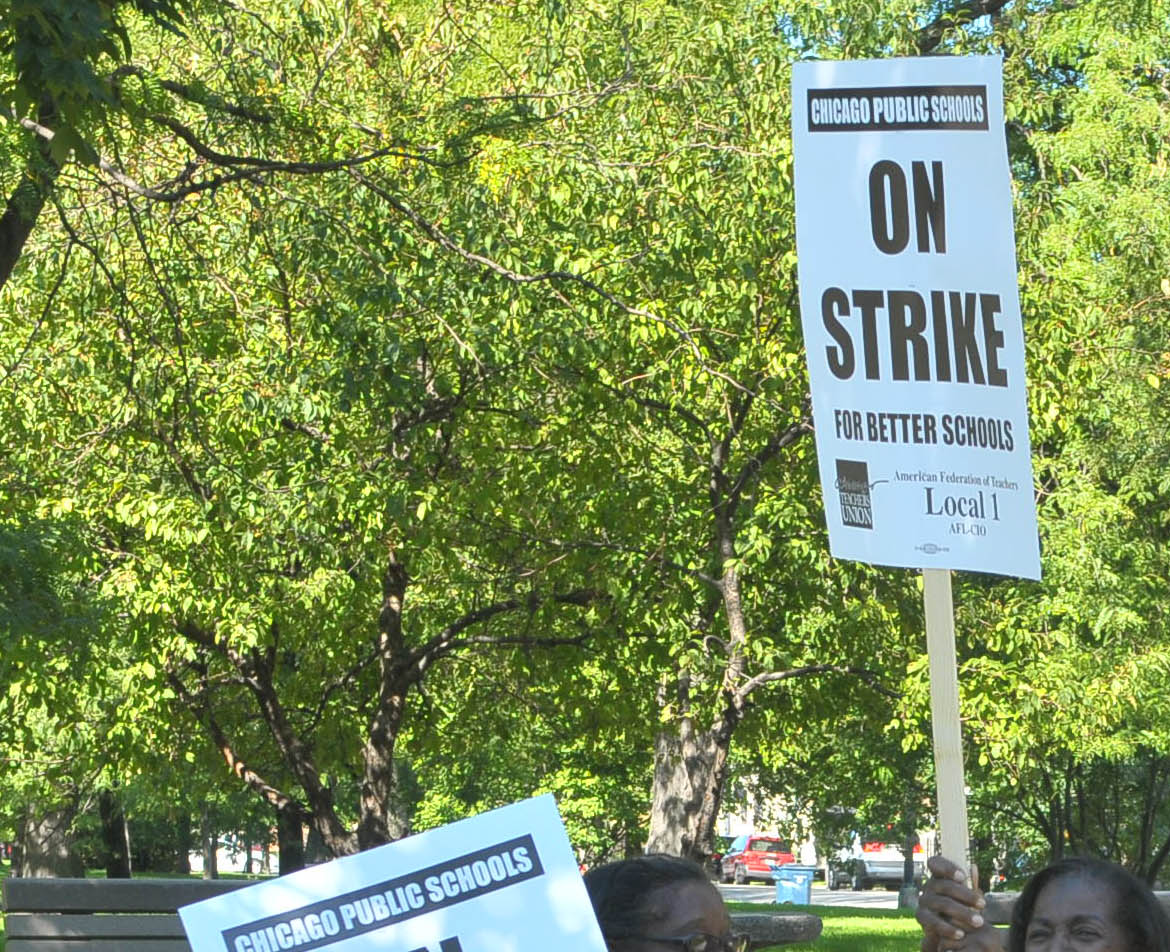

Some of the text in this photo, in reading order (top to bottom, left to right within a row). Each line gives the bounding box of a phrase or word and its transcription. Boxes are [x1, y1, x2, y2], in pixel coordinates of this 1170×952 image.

[811, 95, 984, 125] CHICAGO PUBLIC SCHOOLS
[869, 160, 946, 255] ON
[822, 287, 1008, 387] STRIKE
[834, 409, 1014, 452] FOR BETTER SCHOOLS
[894, 470, 938, 482] American
[940, 471, 982, 486] Federation
[983, 476, 990, 486] of
[842, 505, 872, 525] UNION
[924, 487, 1000, 521] Local 1
[949, 523, 987, 537] AFL-CIO
[339, 882, 425, 931] PUBLIC
[424, 847, 533, 903] SCHOOLS
